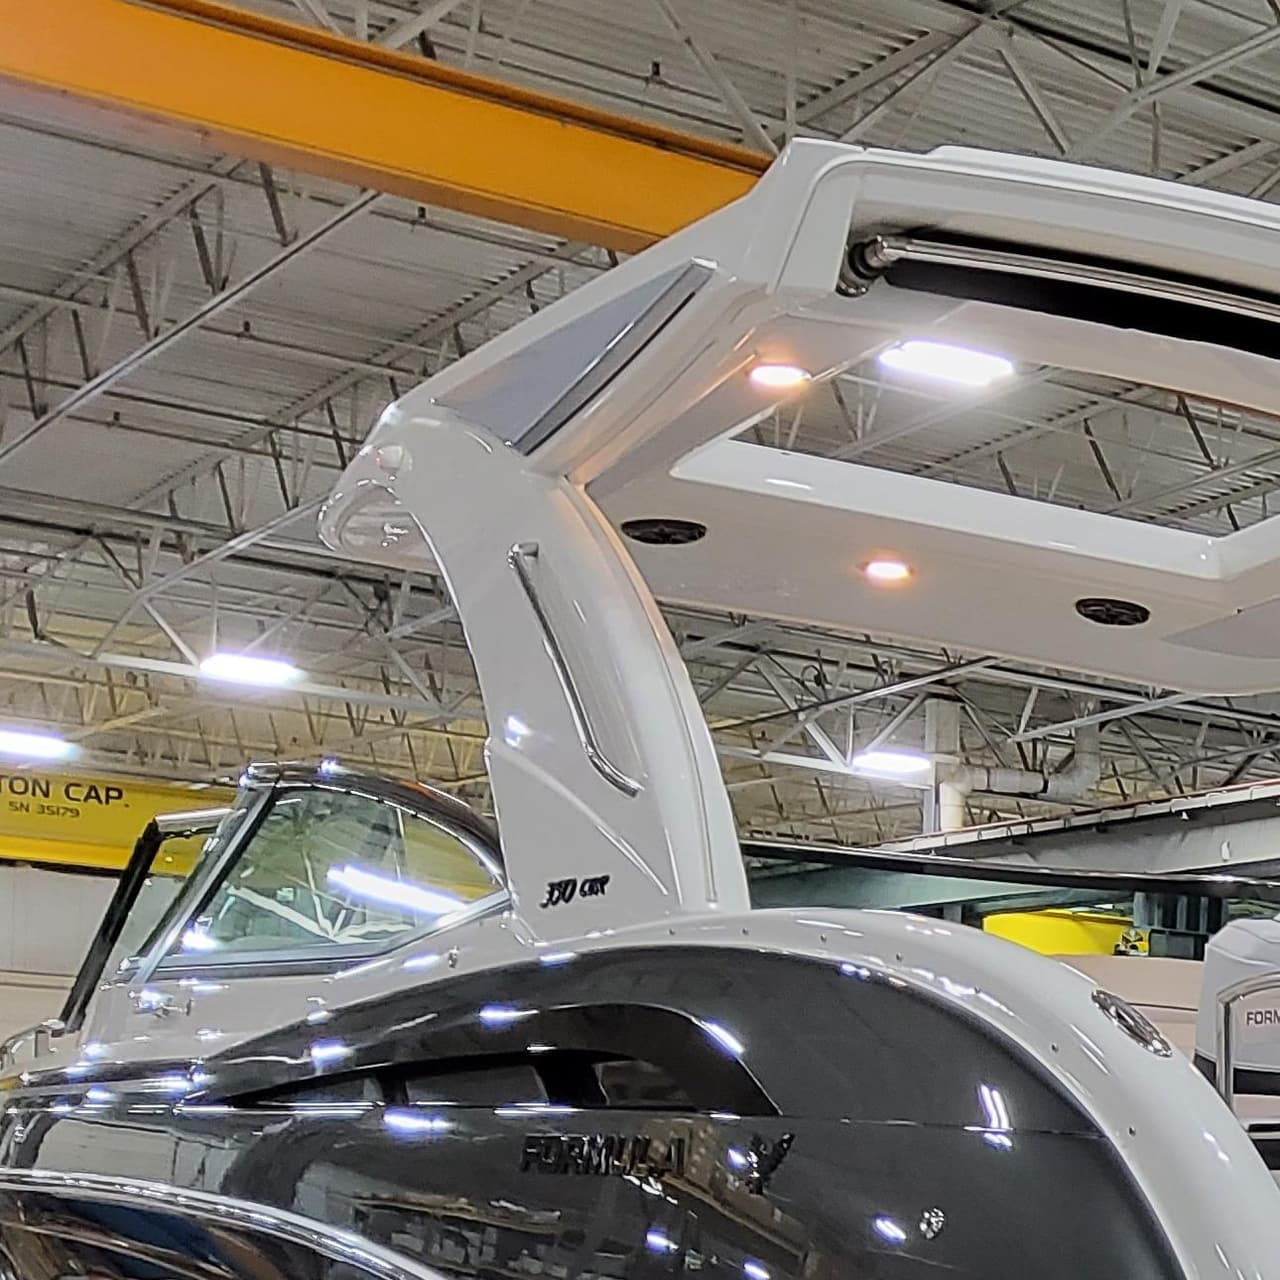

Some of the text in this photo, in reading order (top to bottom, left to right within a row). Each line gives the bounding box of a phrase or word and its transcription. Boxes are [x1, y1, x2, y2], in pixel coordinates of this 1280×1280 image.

[9, 801, 30, 813] SN
[64, 782, 130, 808] CAP.
[520, 1133, 687, 1178] FORMULA
